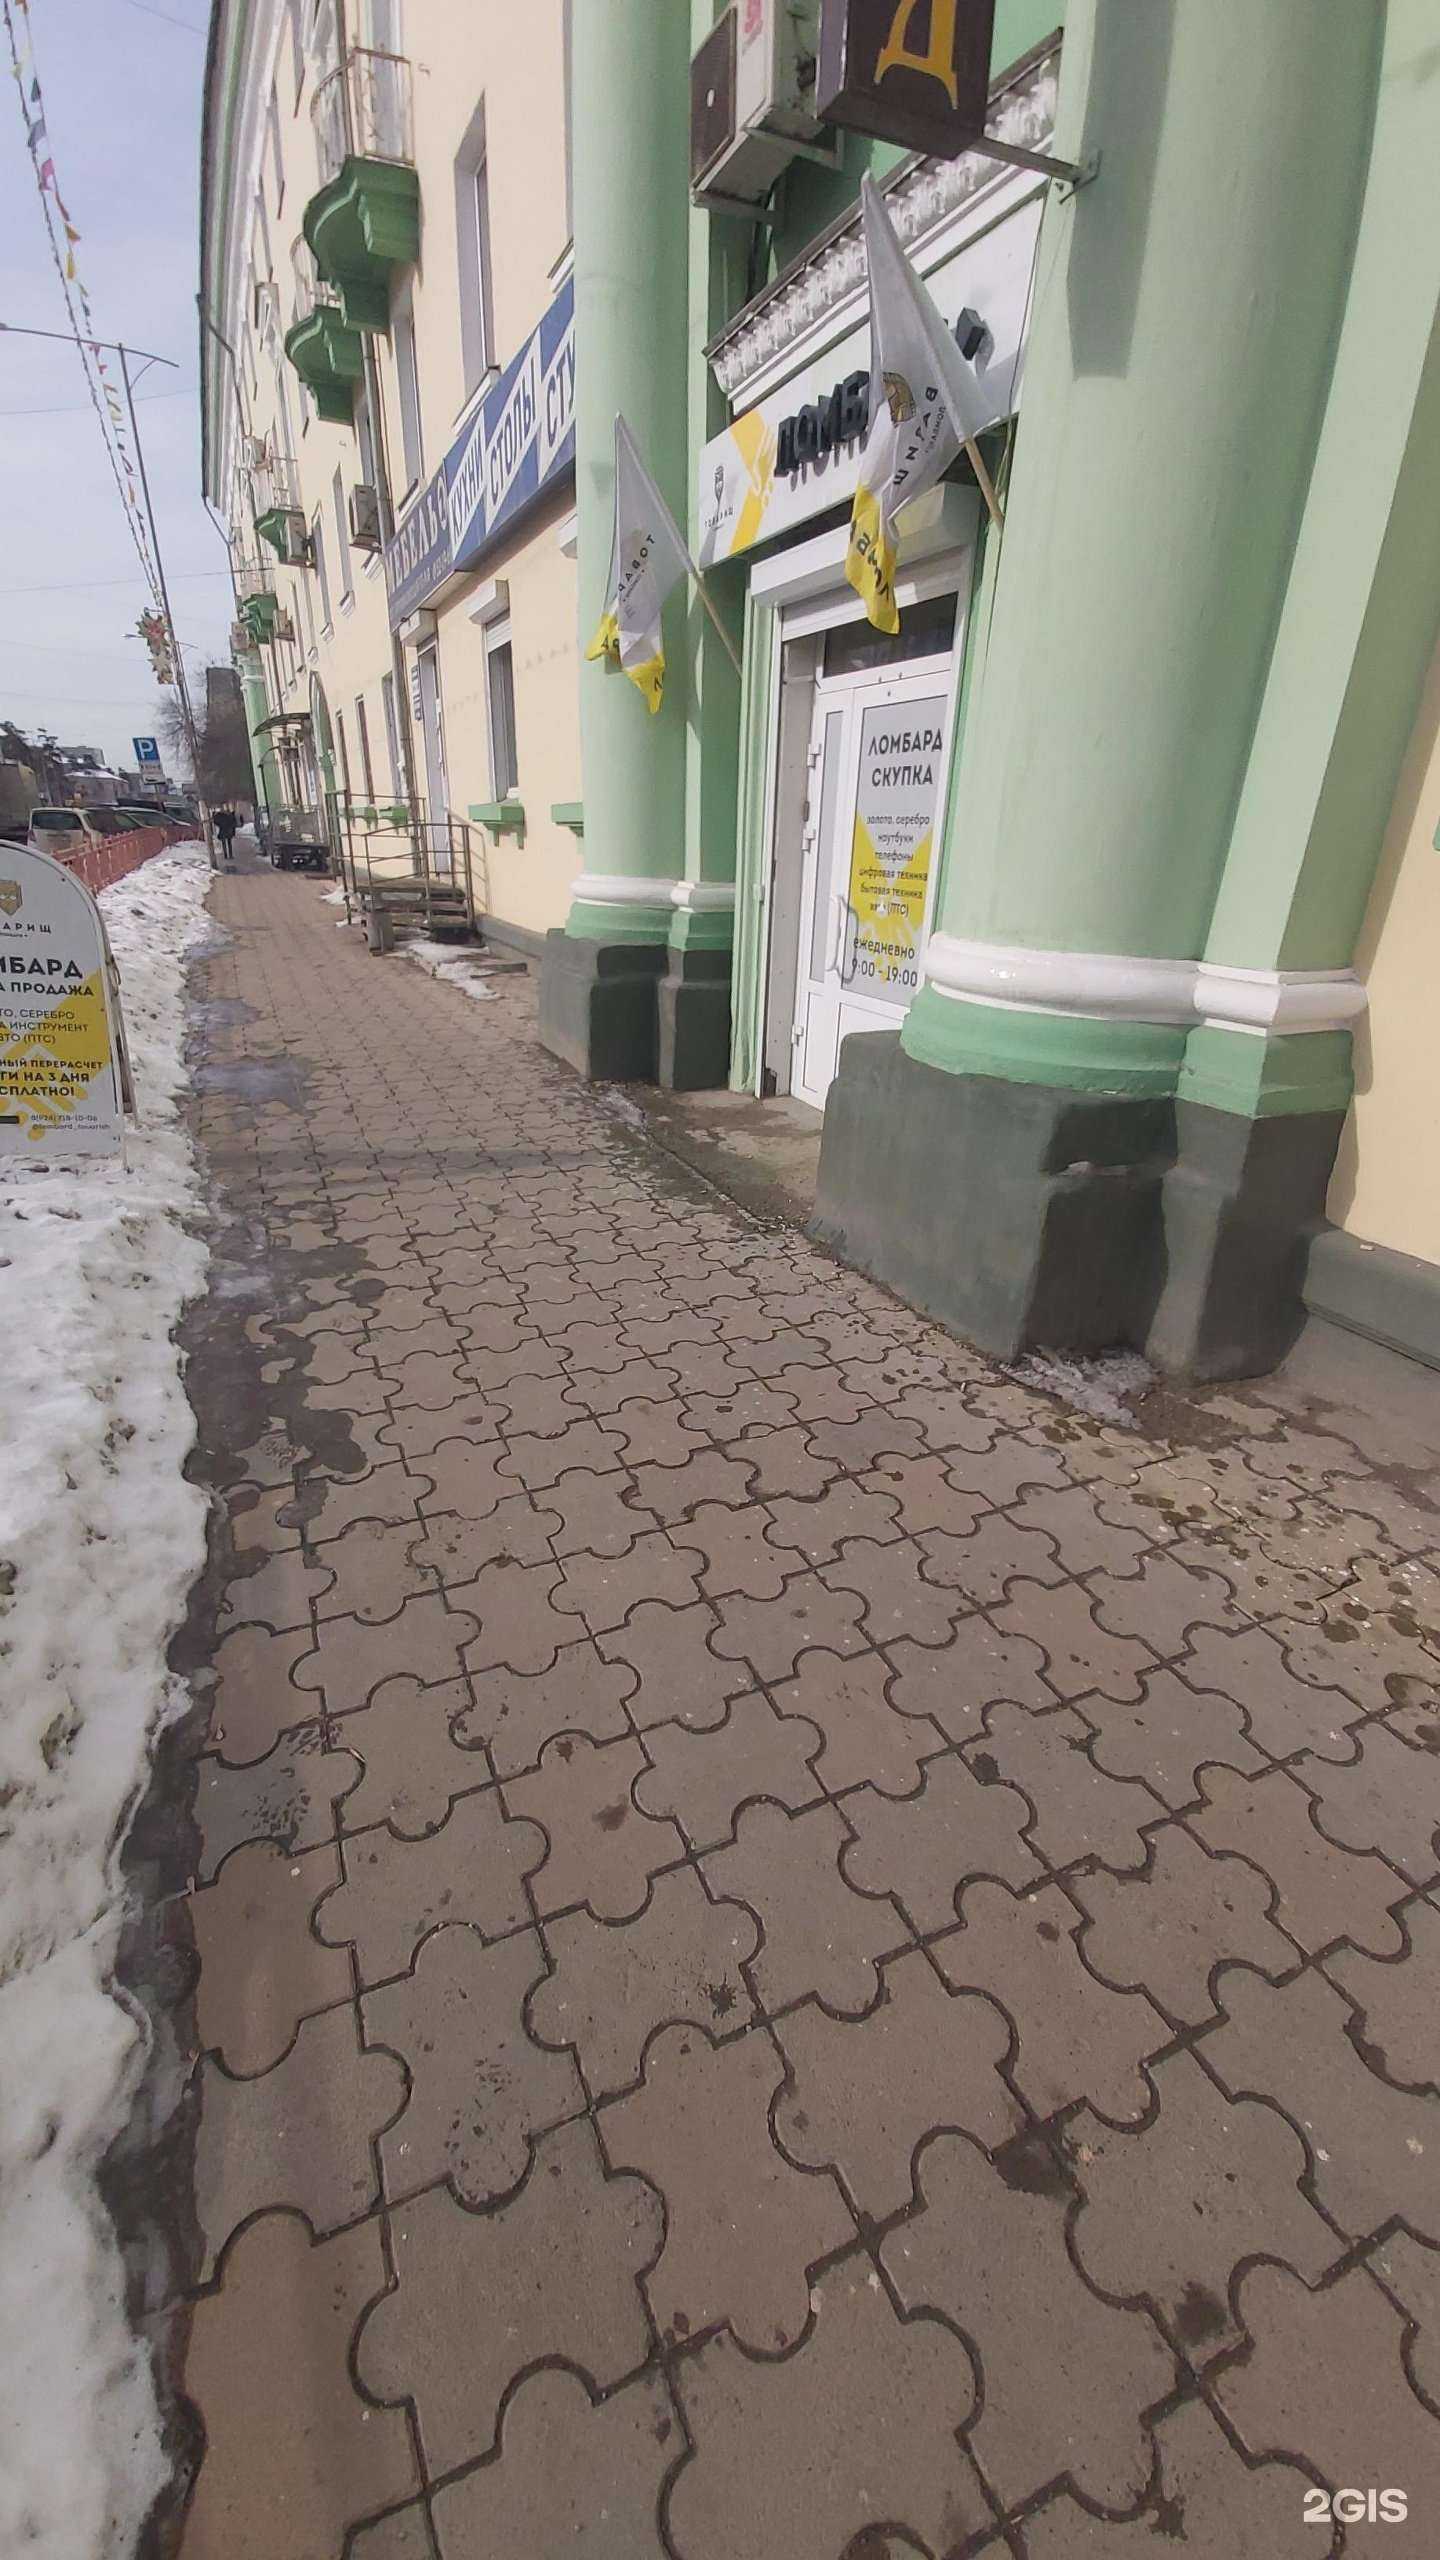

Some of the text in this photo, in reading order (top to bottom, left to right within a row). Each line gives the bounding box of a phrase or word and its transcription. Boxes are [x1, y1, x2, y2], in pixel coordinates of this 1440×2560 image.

[490, 357, 536, 506] СТОЛЫ
[449, 426, 484, 545] КУХНИ
[868, 728, 943, 756] ЛОМБАРД
[871, 764, 934, 788] СКУПКА
[895, 812, 930, 828] серебро
[853, 937, 915, 960] ежедневно
[852, 958, 875, 978] 9:00
[886, 965, 918, 987] 19:00
[11, 982, 95, 997] ПРОДАЖА
[20, 1008, 75, 1020] СЕРЕБРО
[10, 1022, 88, 1033] ИНСТРУМЕНТ
[24, 1034, 56, 1045] (ПТС)
[31, 1060, 103, 1070] ПЕРЕРАСЧЕТ
[24, 1072, 44, 1082] НА
[48, 1073, 57, 1082] 3
[60, 1073, 90, 1083] ДНЯ
